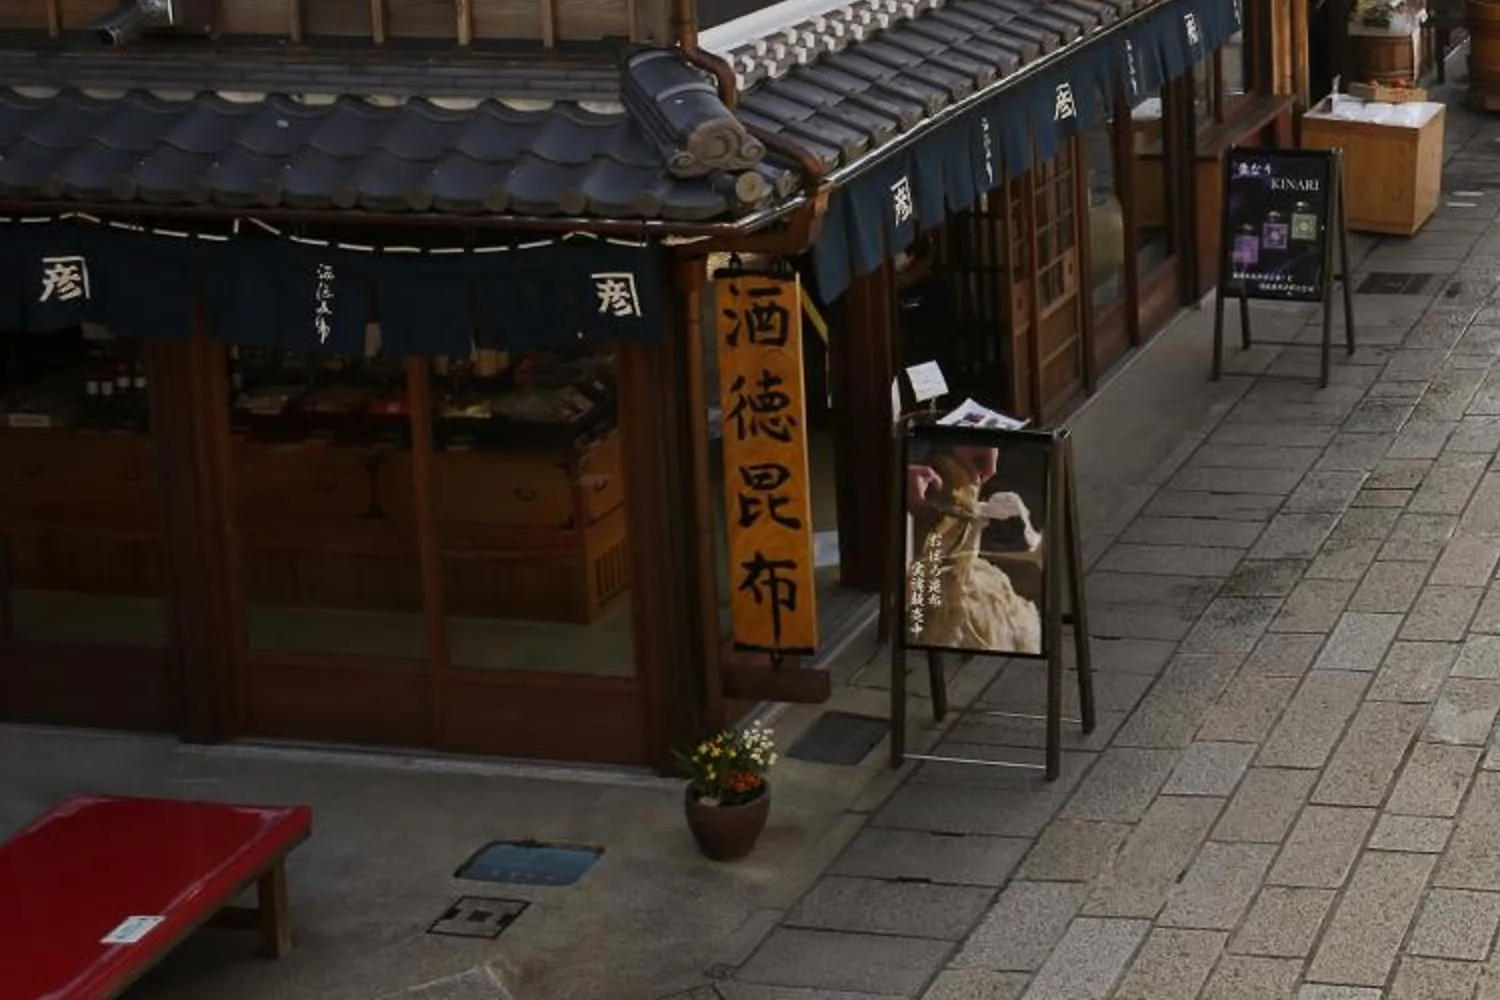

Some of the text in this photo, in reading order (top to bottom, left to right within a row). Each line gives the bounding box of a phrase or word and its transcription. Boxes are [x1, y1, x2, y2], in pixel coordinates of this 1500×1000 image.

[1271, 178, 1320, 191] KINARI
[722, 284, 802, 647] 酒徳昆布
